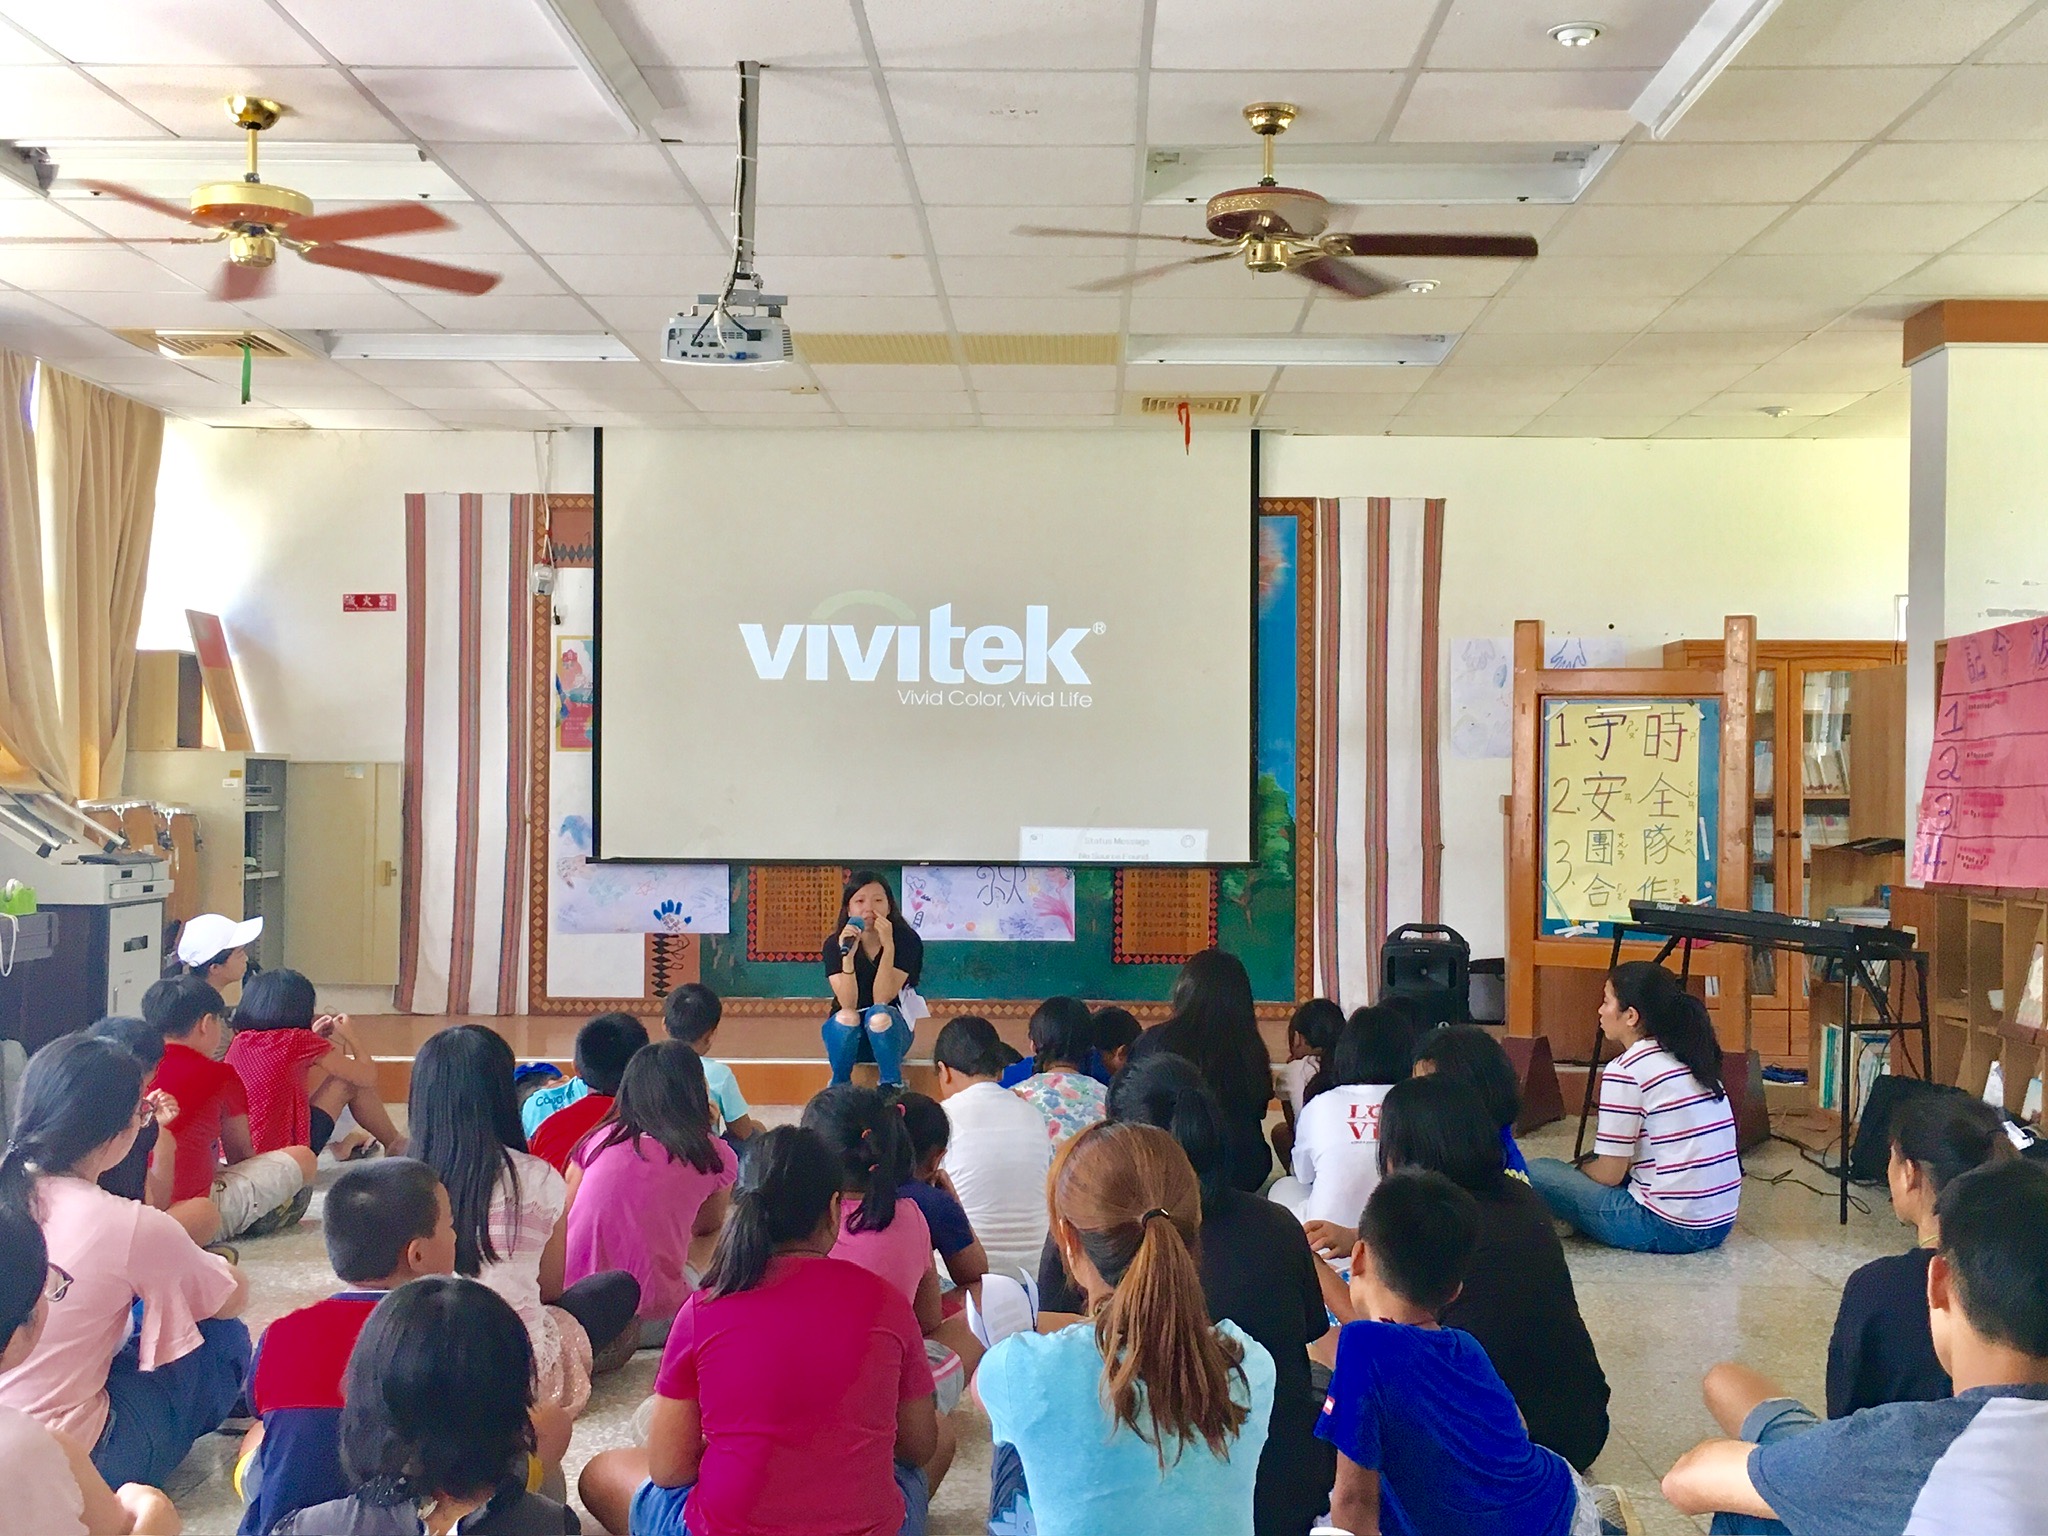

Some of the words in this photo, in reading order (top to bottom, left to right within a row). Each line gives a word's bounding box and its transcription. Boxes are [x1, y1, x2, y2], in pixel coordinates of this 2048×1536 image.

[897, 689, 943, 706] Vivid
[948, 689, 1005, 708] Color,
[1008, 690, 1056, 707] Vivid
[1059, 691, 1093, 708] Life
[1941, 701, 1963, 736] 1
[1936, 745, 1962, 782] 2
[1586, 823, 1686, 866] 團隊
